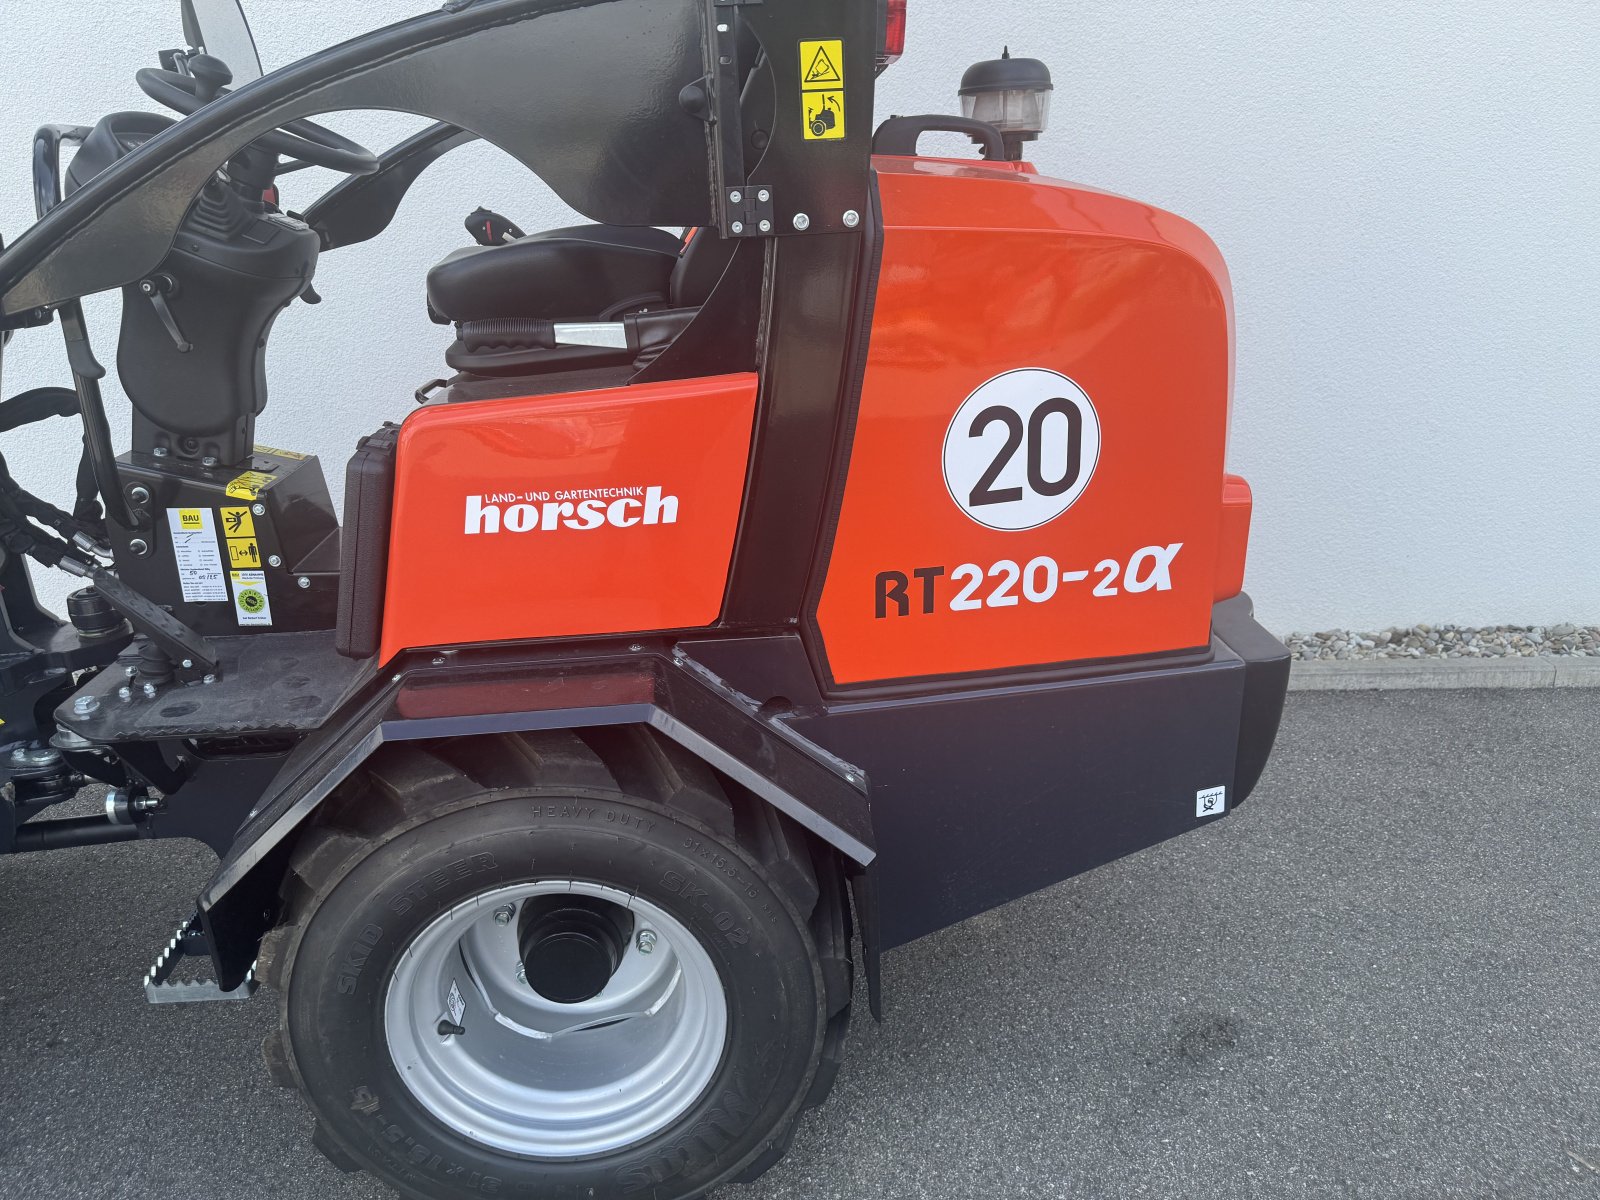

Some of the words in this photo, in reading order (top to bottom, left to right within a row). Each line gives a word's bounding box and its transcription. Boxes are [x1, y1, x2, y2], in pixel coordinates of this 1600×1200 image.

[968, 397, 1082, 507] 20
[464, 485, 679, 535] horsch
[554, 486, 644, 501] GARTENTECHNIK
[182, 514, 200, 522] BAU
[531, 805, 596, 819] HEAVY
[606, 808, 657, 833] DUTY
[336, 922, 385, 996] SKID
[388, 851, 499, 916] STEER
